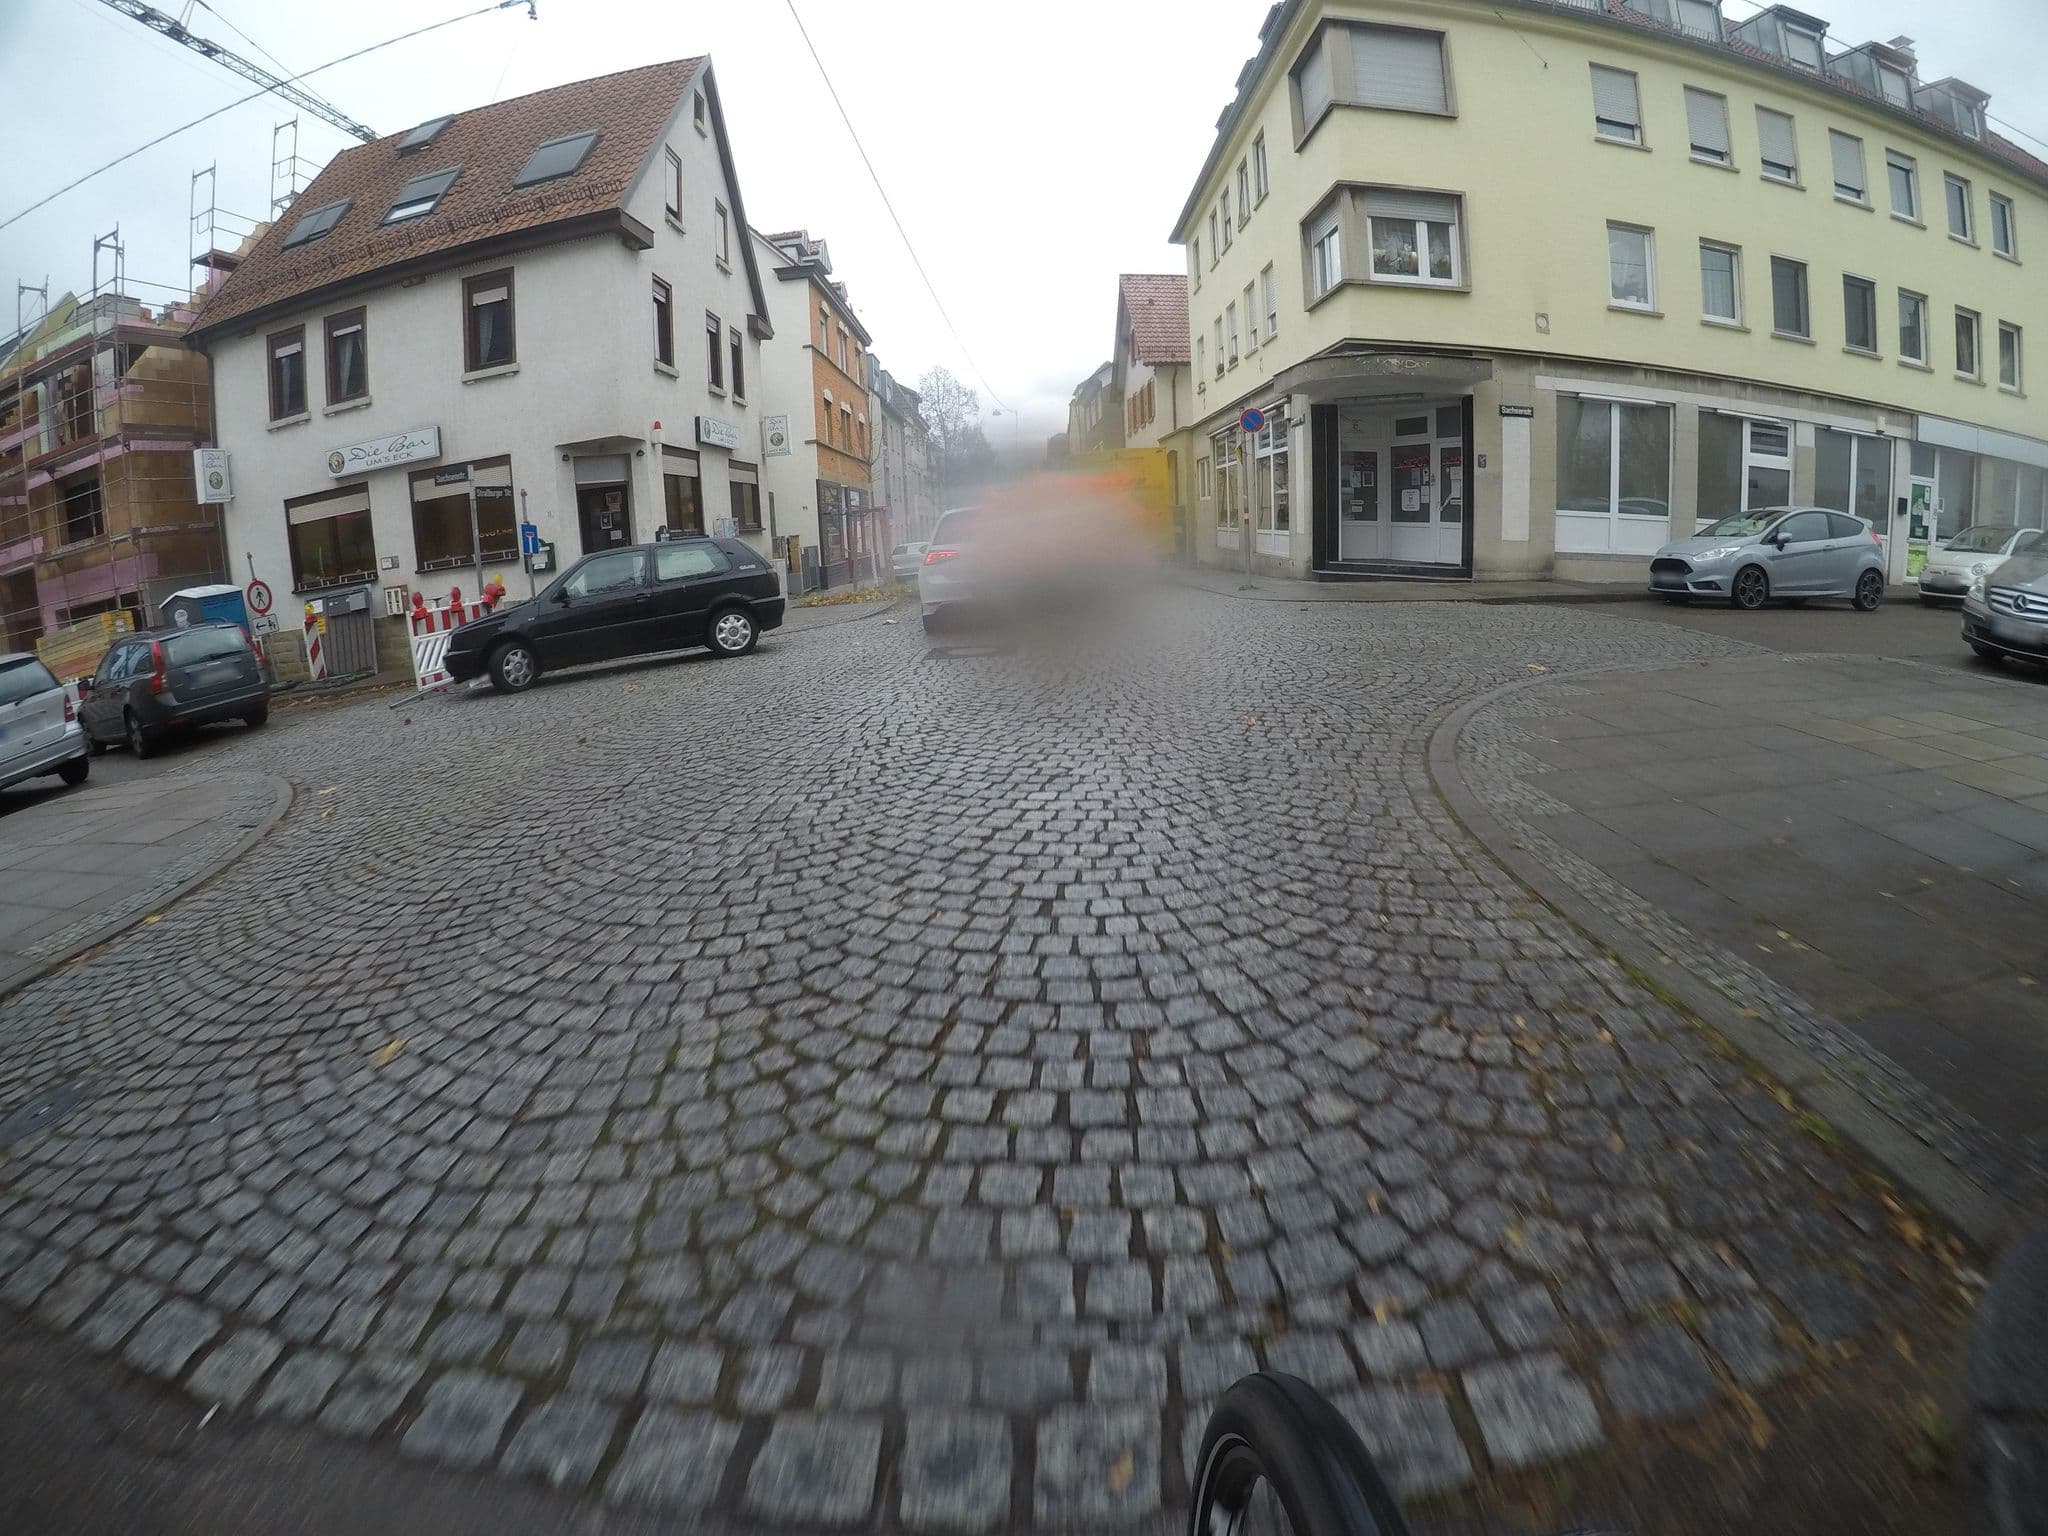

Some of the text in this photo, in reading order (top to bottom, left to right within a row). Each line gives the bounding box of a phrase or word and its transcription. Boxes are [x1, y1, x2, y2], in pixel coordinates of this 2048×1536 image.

[348, 435, 430, 462] Die Bar
[393, 451, 414, 461] ECK
